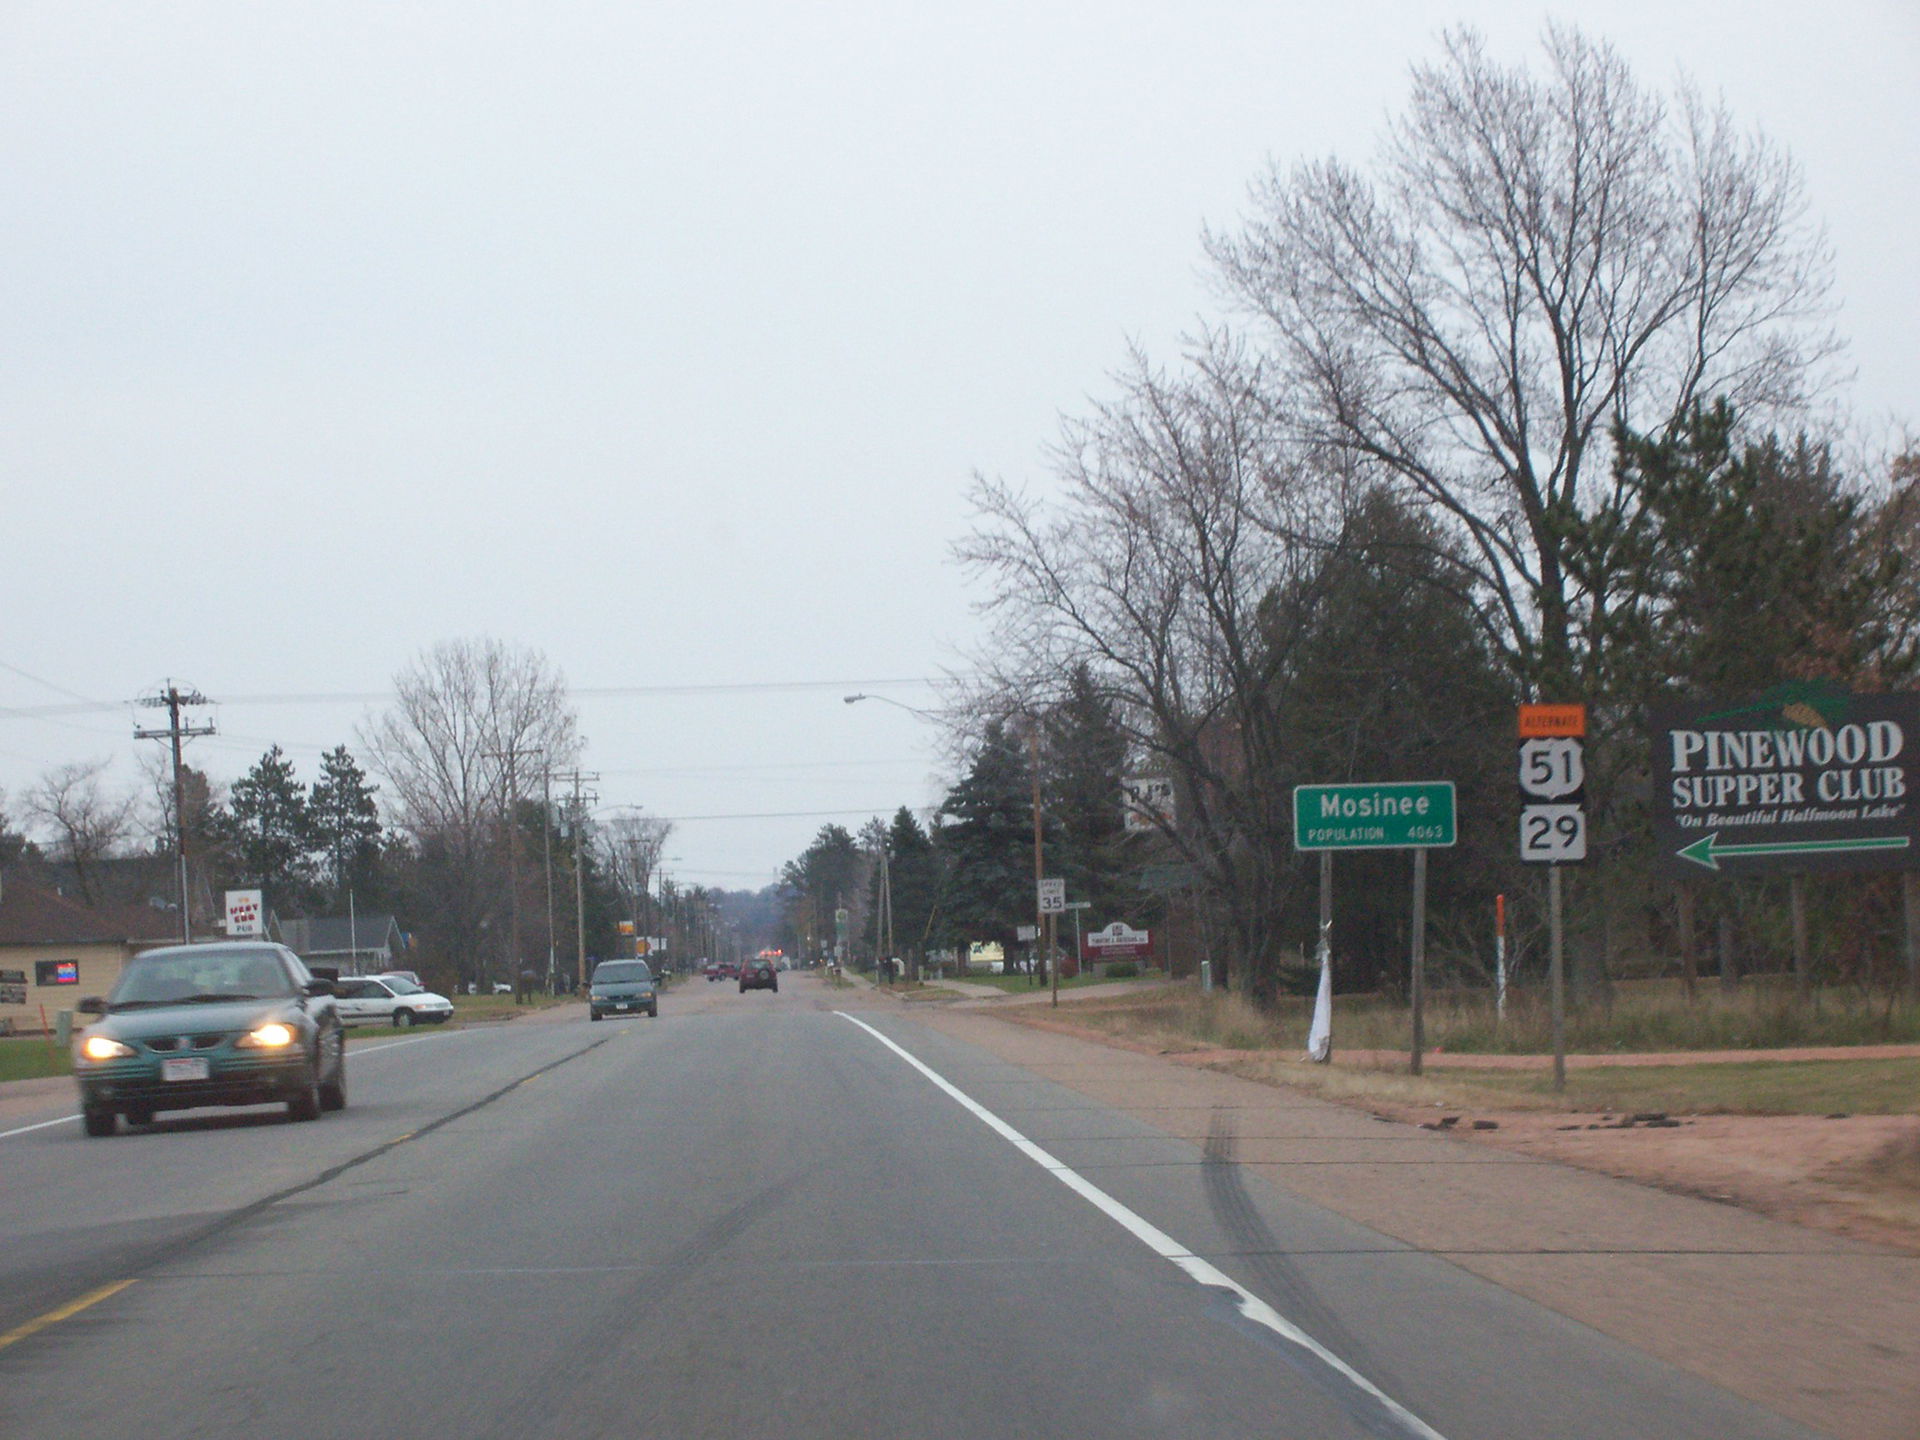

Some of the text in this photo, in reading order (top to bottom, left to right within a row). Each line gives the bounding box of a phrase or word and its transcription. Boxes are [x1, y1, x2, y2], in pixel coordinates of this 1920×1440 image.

[1669, 720, 1904, 772] PINEWOOD
[1530, 750, 1571, 784] 51
[1672, 766, 1906, 808] SUPPER CLUB
[1321, 792, 1430, 818] Mosinee
[1706, 809, 1778, 827] Beautiful
[1781, 806, 1858, 823] Halfmoon
[1308, 825, 1443, 841] POPULATION 4063
[1528, 815, 1579, 849] 29
[1042, 896, 1062, 910] 35
